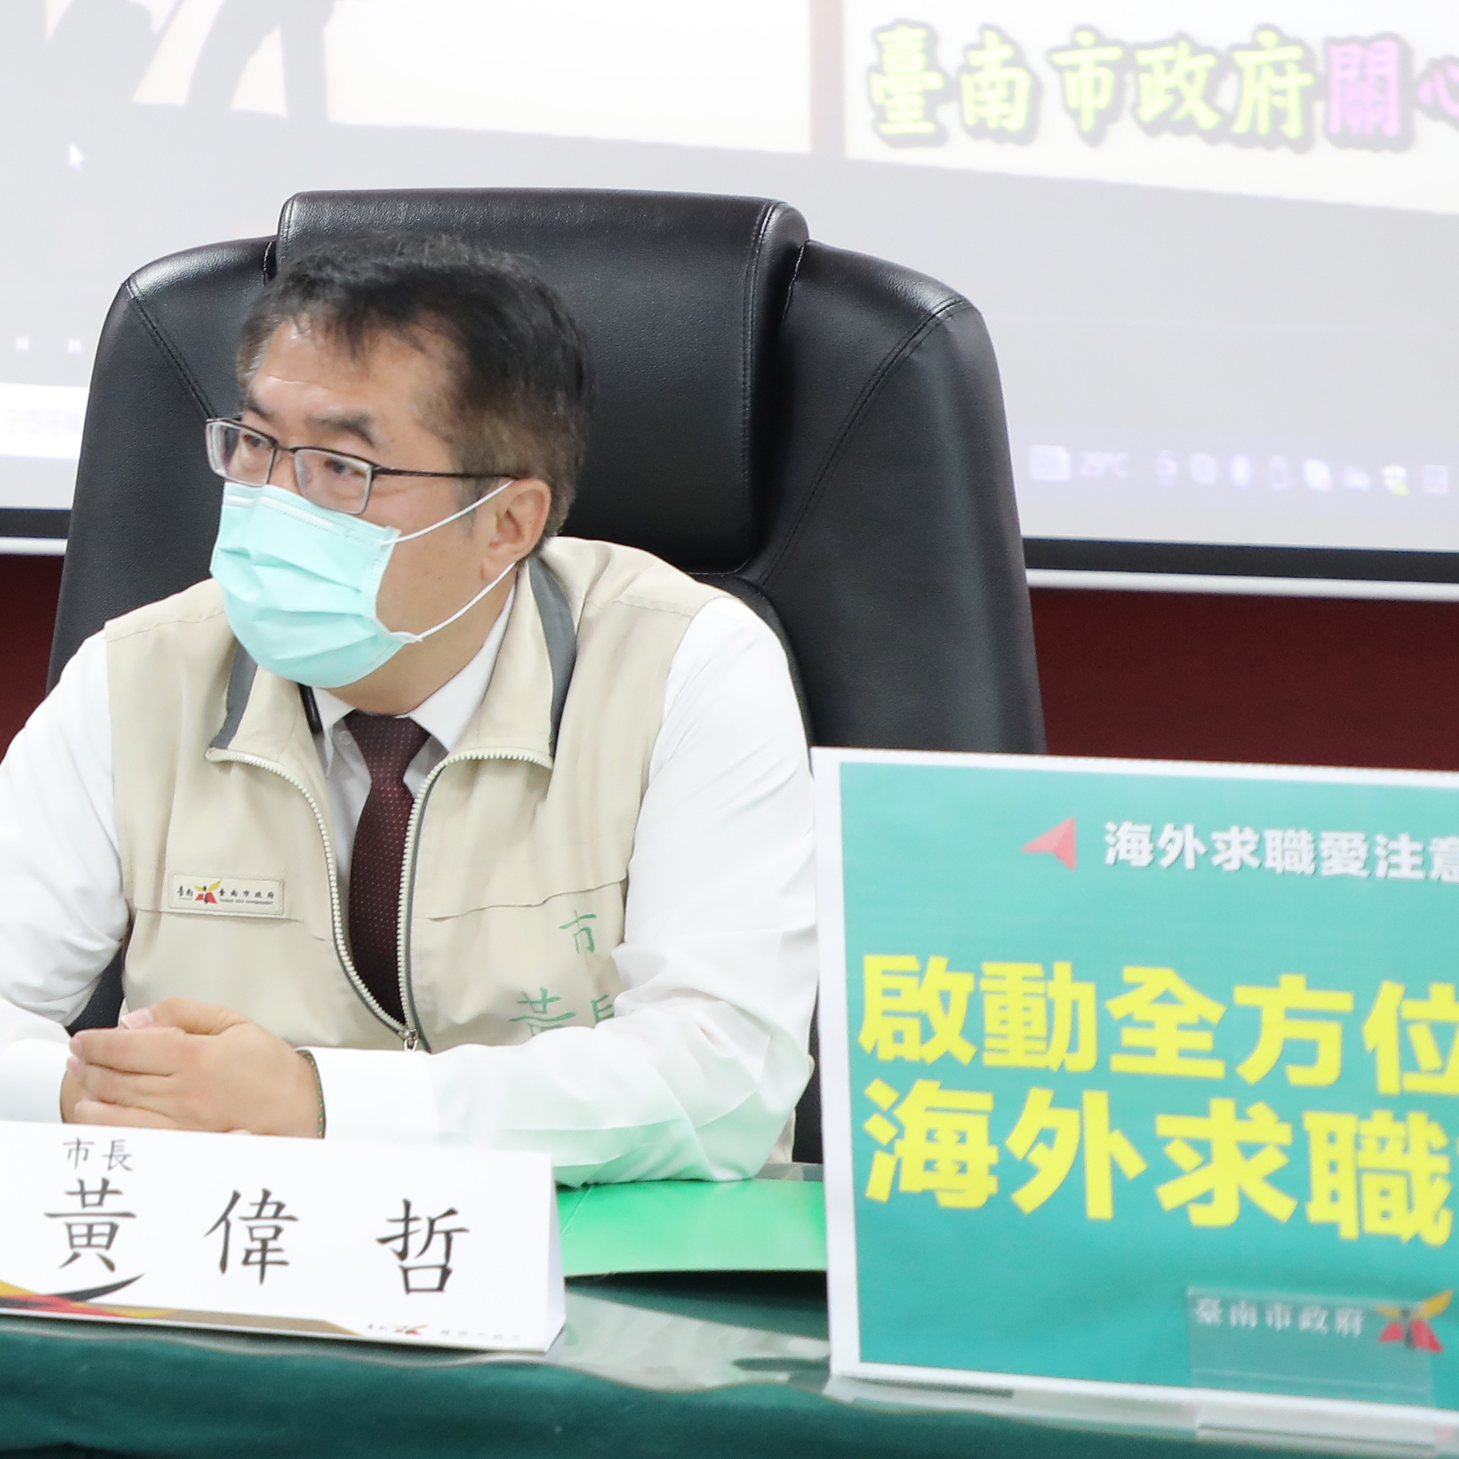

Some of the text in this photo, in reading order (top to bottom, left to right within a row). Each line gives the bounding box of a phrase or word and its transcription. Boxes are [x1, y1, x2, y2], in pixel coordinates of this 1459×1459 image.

[858, 954, 1459, 1097] 啟動全方位
[63, 1136, 135, 1174] 市長
[863, 1078, 1459, 1248] 海外求職
[44, 1176, 471, 1296] 黃偉哲
